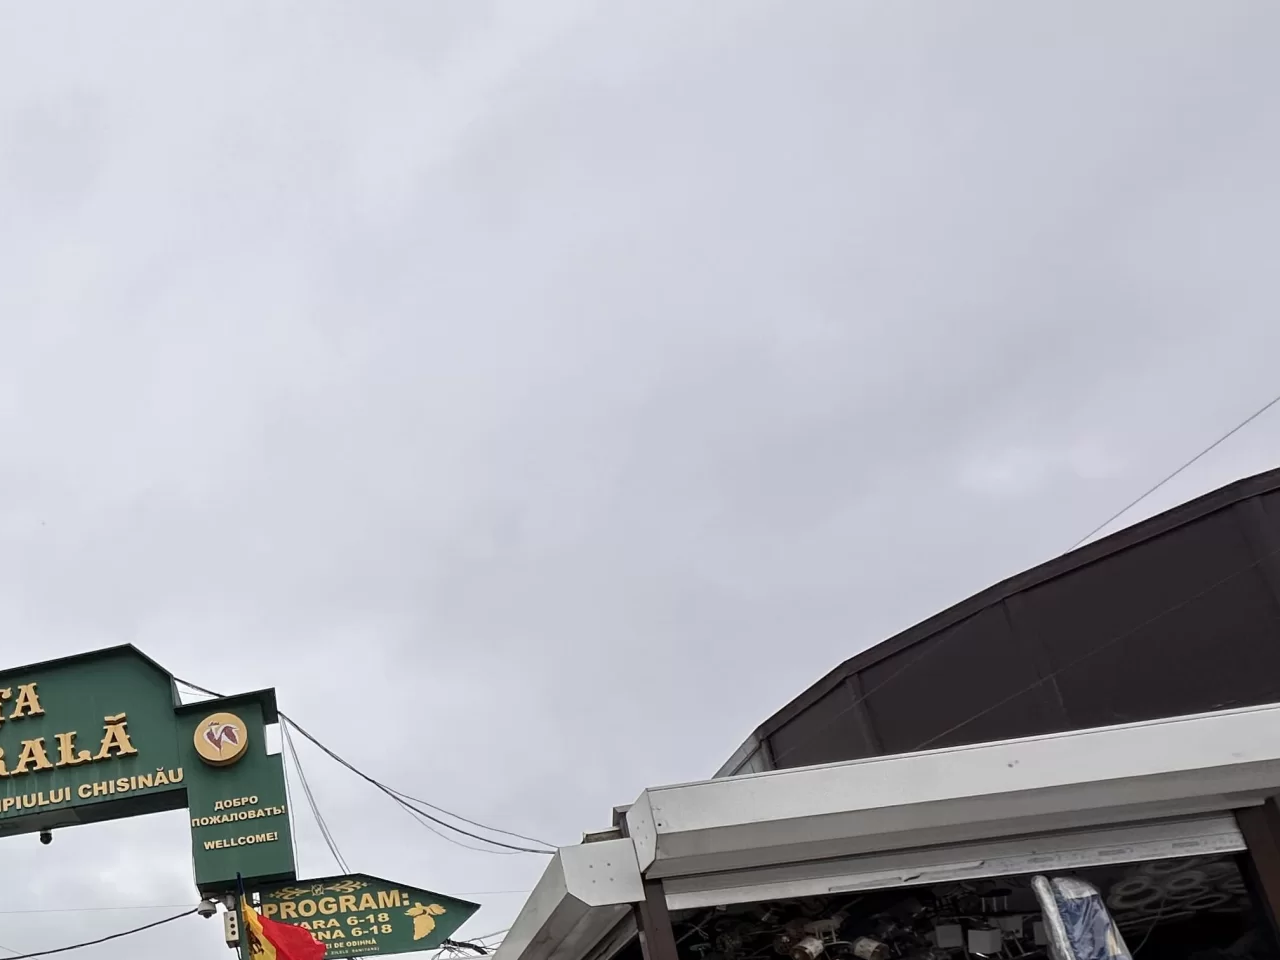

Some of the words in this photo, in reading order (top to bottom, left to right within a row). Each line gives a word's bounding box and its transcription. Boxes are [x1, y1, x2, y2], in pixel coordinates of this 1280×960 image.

[77, 767, 184, 798] CHISINĂU
[214, 795, 259, 812] ДОБРО
[191, 805, 286, 827] ПОЖАЛОВАТЬ!
[203, 831, 278, 850] WELLCOME!
[262, 889, 410, 920] PROGRAM:
[294, 918, 344, 931] ARA
[346, 913, 390, 926] 6-18
[351, 924, 393, 937] 6-18
